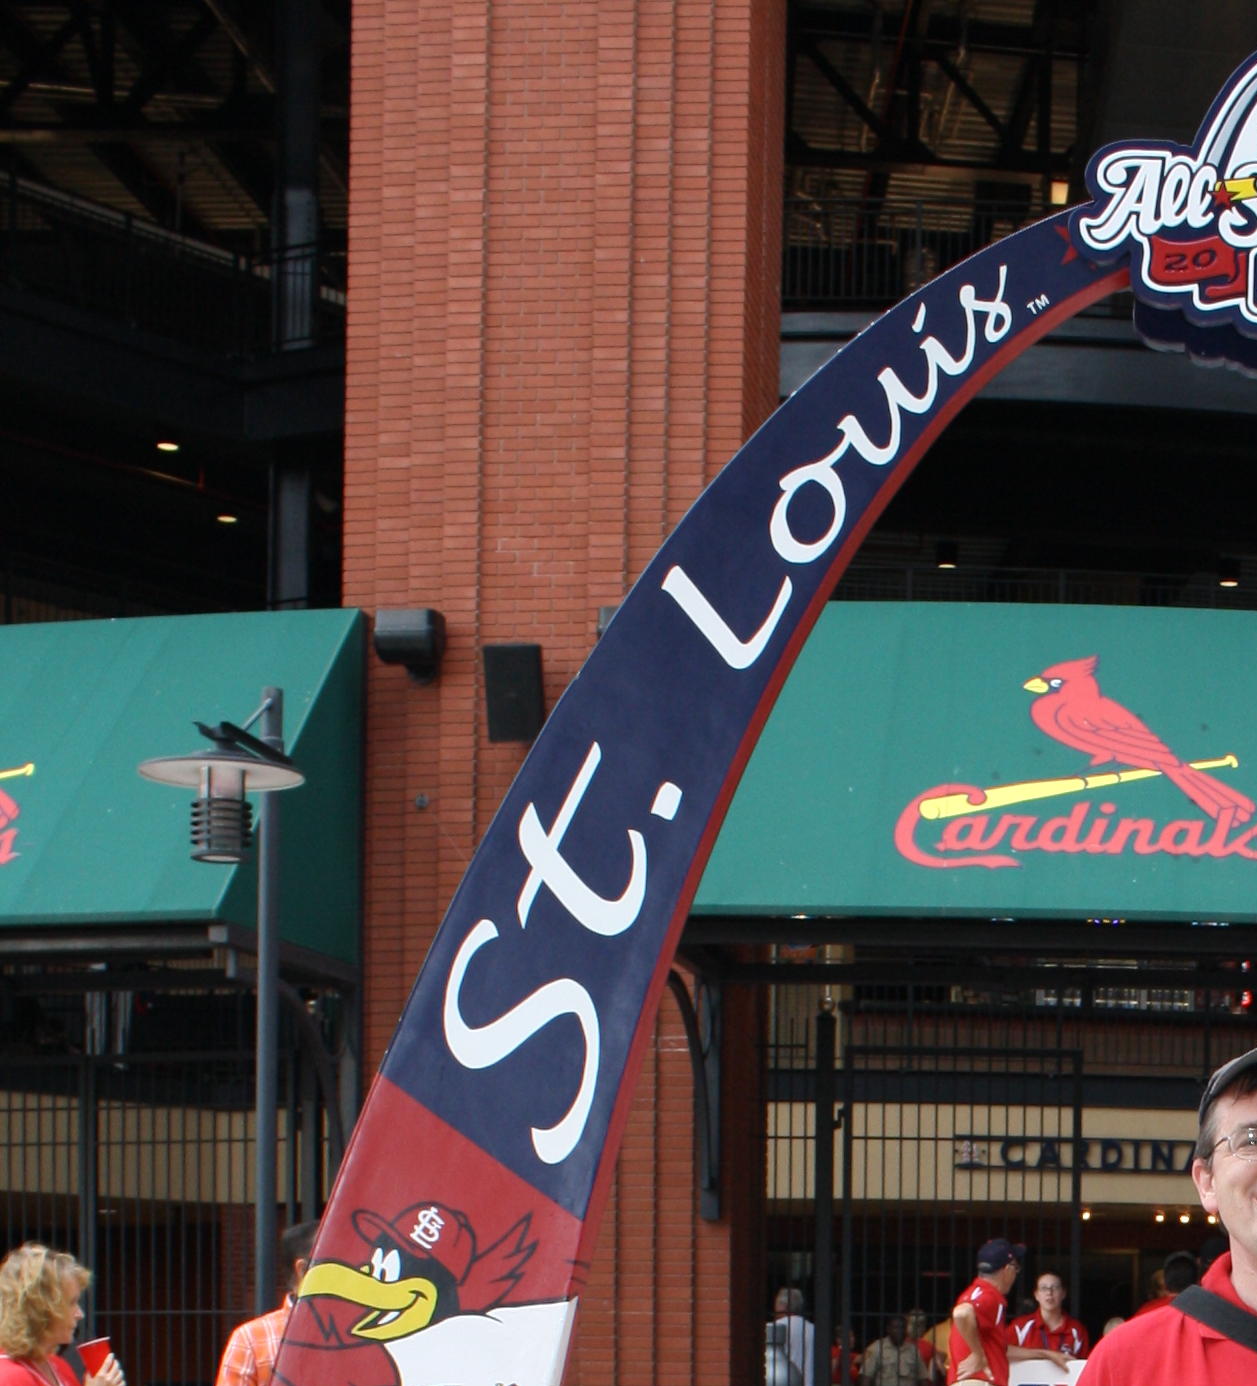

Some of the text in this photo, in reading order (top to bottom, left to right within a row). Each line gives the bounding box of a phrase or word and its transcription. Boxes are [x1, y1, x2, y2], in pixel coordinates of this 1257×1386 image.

[1080, 151, 1219, 249] All
[1163, 248, 1212, 273] 20
[443, 742, 684, 1164] St.
[661, 264, 1014, 670] Louis
